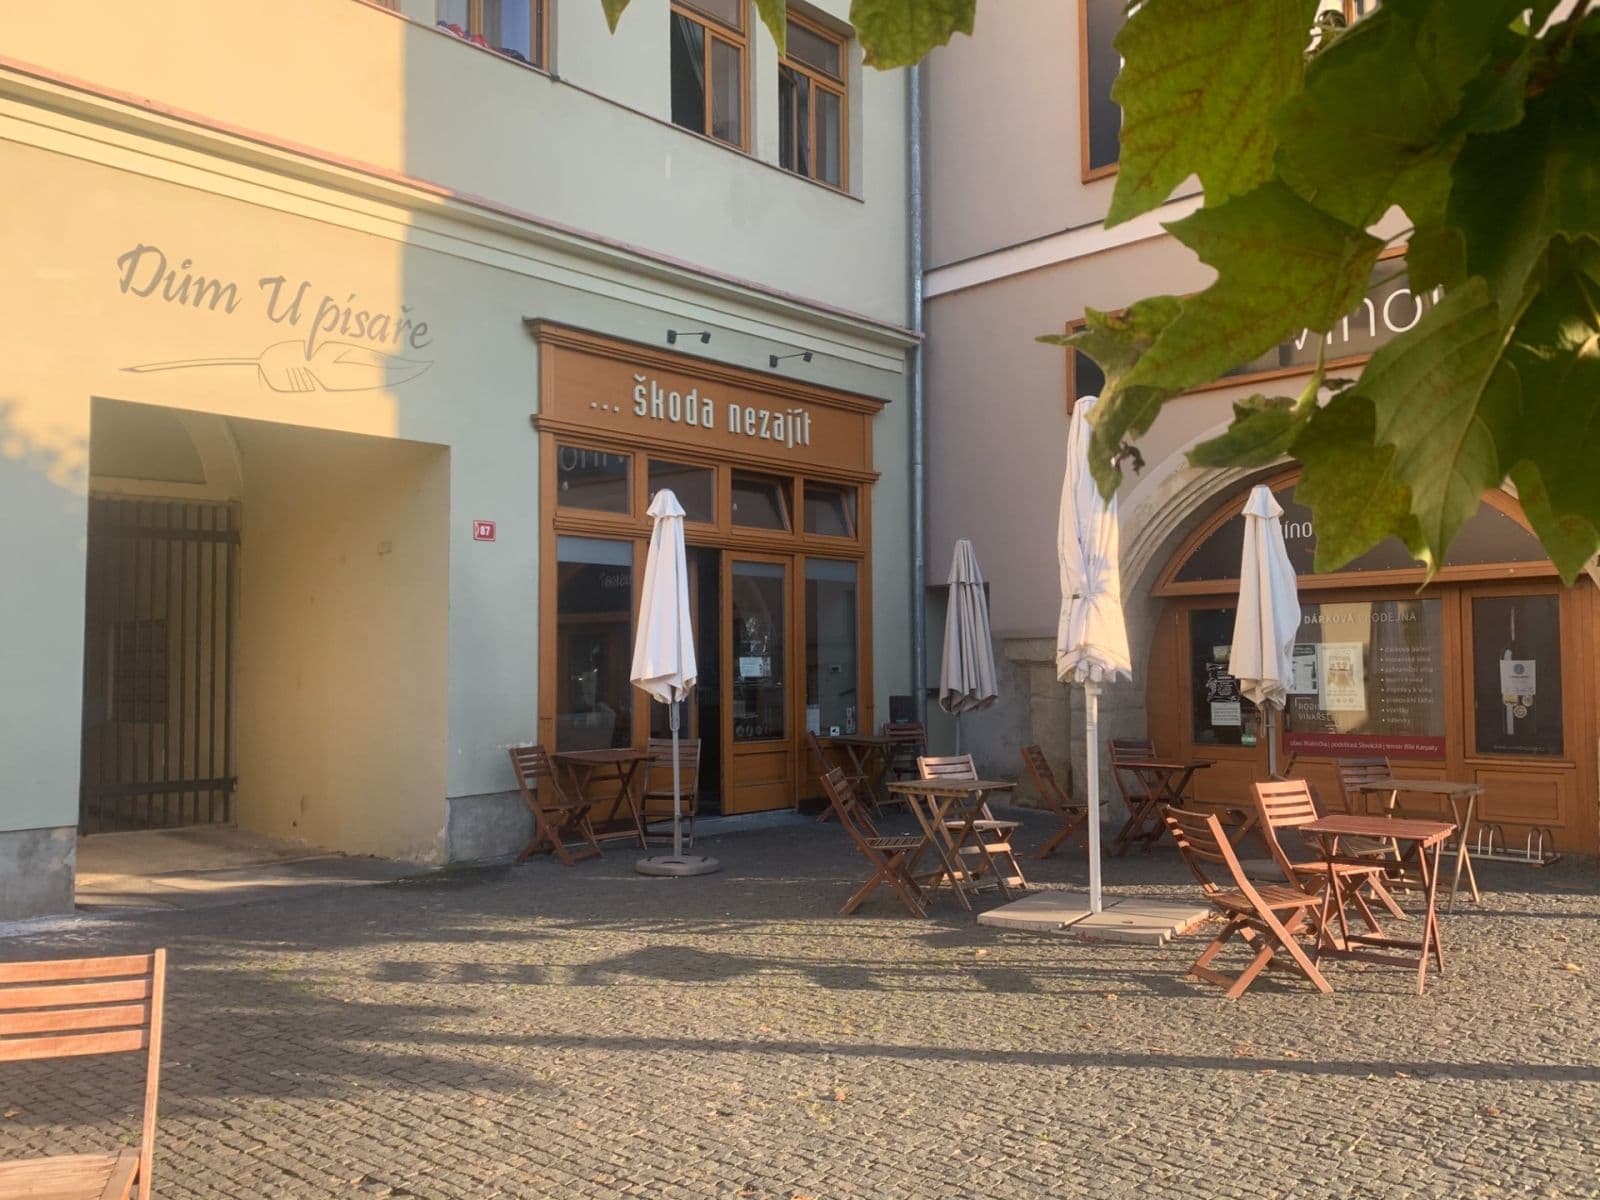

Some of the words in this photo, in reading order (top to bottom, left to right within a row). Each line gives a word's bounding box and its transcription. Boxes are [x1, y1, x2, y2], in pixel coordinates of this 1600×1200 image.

[117, 243, 242, 314] Dům
[259, 275, 312, 326] U
[304, 293, 433, 361] písaře
[633, 373, 714, 429] škoda
[728, 403, 811, 449] nezajít
[479, 524, 491, 537] 87
